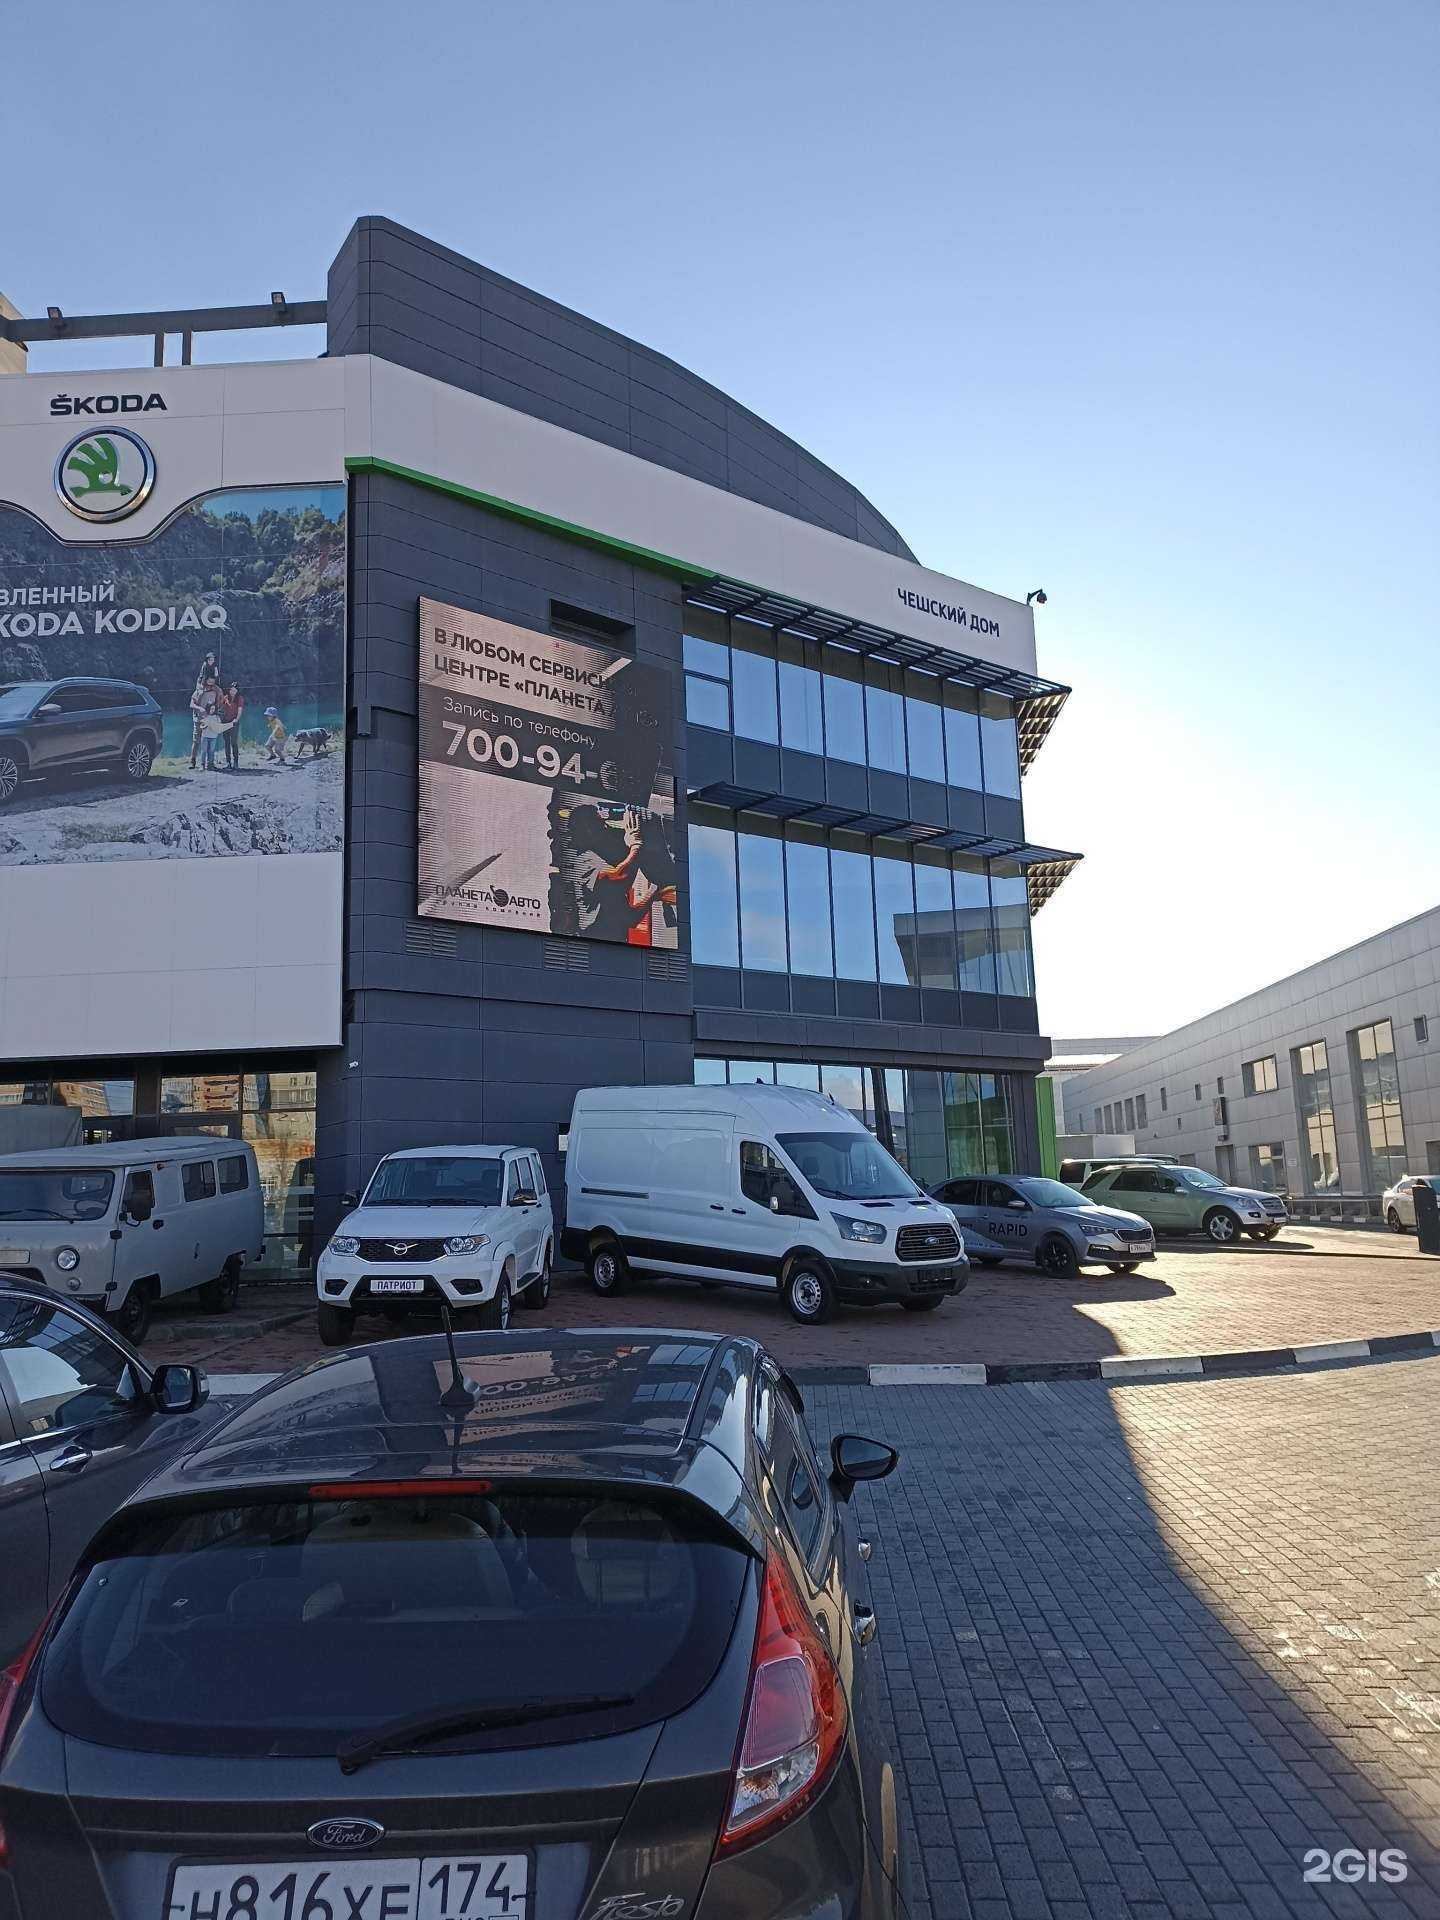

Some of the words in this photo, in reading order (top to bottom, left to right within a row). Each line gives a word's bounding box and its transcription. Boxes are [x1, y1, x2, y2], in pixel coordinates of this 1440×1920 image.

[50, 393, 168, 416] ŠKODA
[95, 604, 231, 635] KODIAQ
[897, 587, 967, 627] ЧЕШСКИЙ
[969, 613, 1000, 638] ДОМ
[434, 627, 447, 645] В
[451, 632, 525, 668] ЛЮБОМ
[434, 653, 510, 688] ЦЕНТРЕ
[443, 696, 499, 723] Запись
[504, 714, 523, 730] по
[528, 720, 596, 749] телефону
[989, 1222, 1028, 1237] RAPID
[377, 1281, 416, 1290] ПАТРИОТ
[322, 1824, 366, 1844] Ford
[428, 1862, 510, 1914] 174
